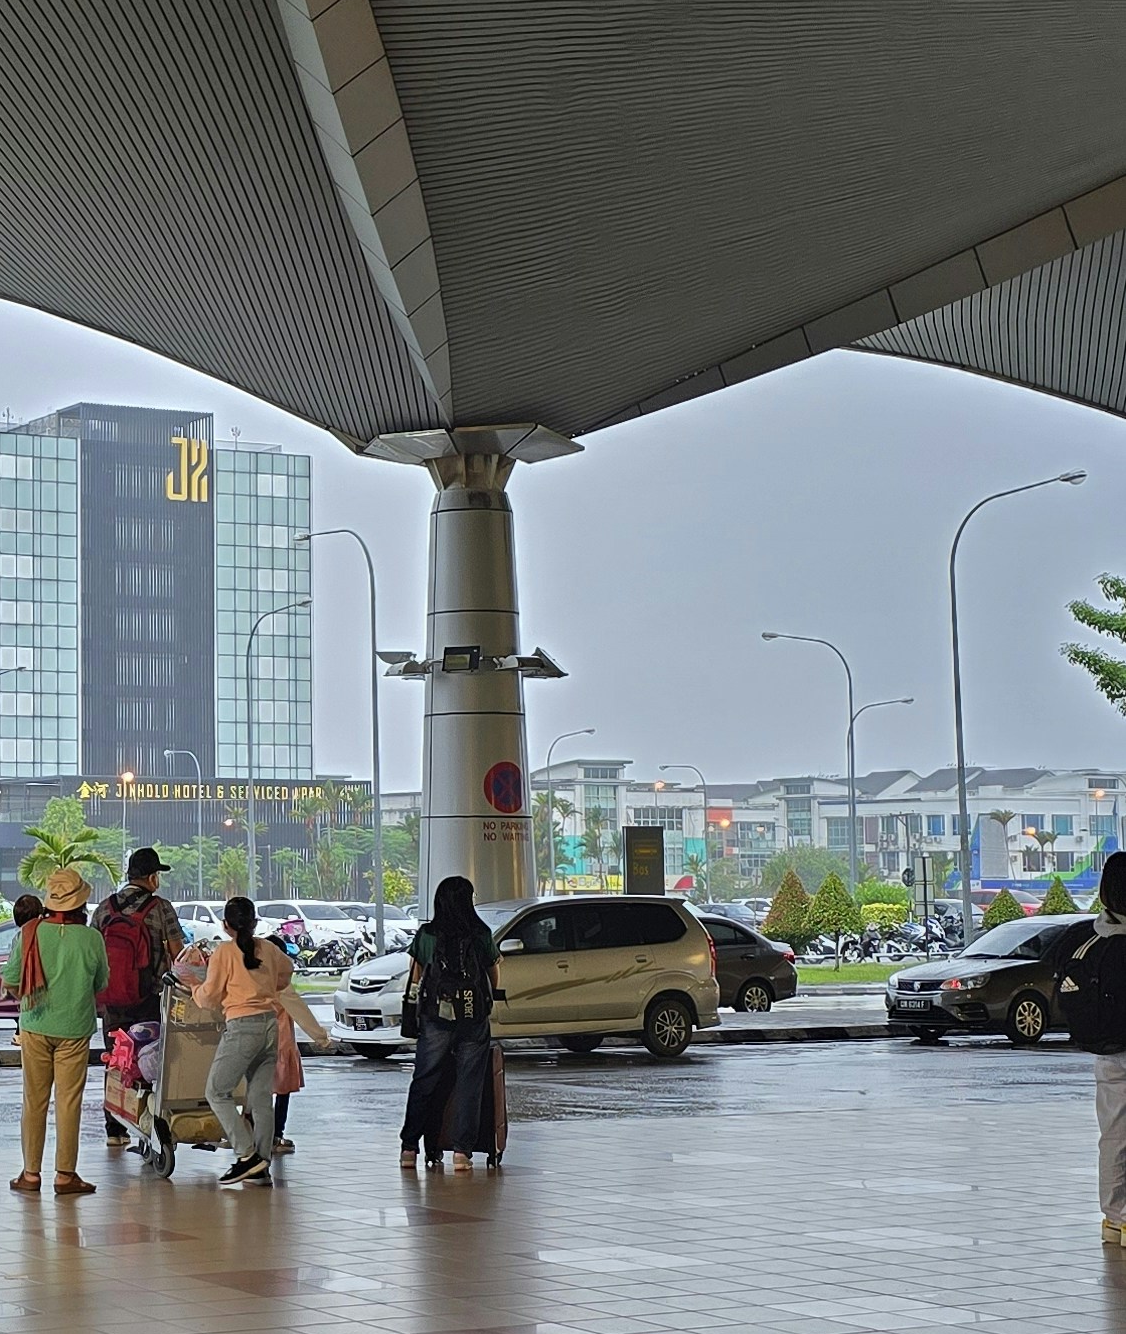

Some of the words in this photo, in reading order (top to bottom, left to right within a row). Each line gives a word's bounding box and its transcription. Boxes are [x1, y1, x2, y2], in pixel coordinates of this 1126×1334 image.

[173, 784, 212, 799] HOTEL
[483, 821, 496, 830] NO
[484, 832, 497, 841] NO
[463, 989, 474, 1019] SPORT
